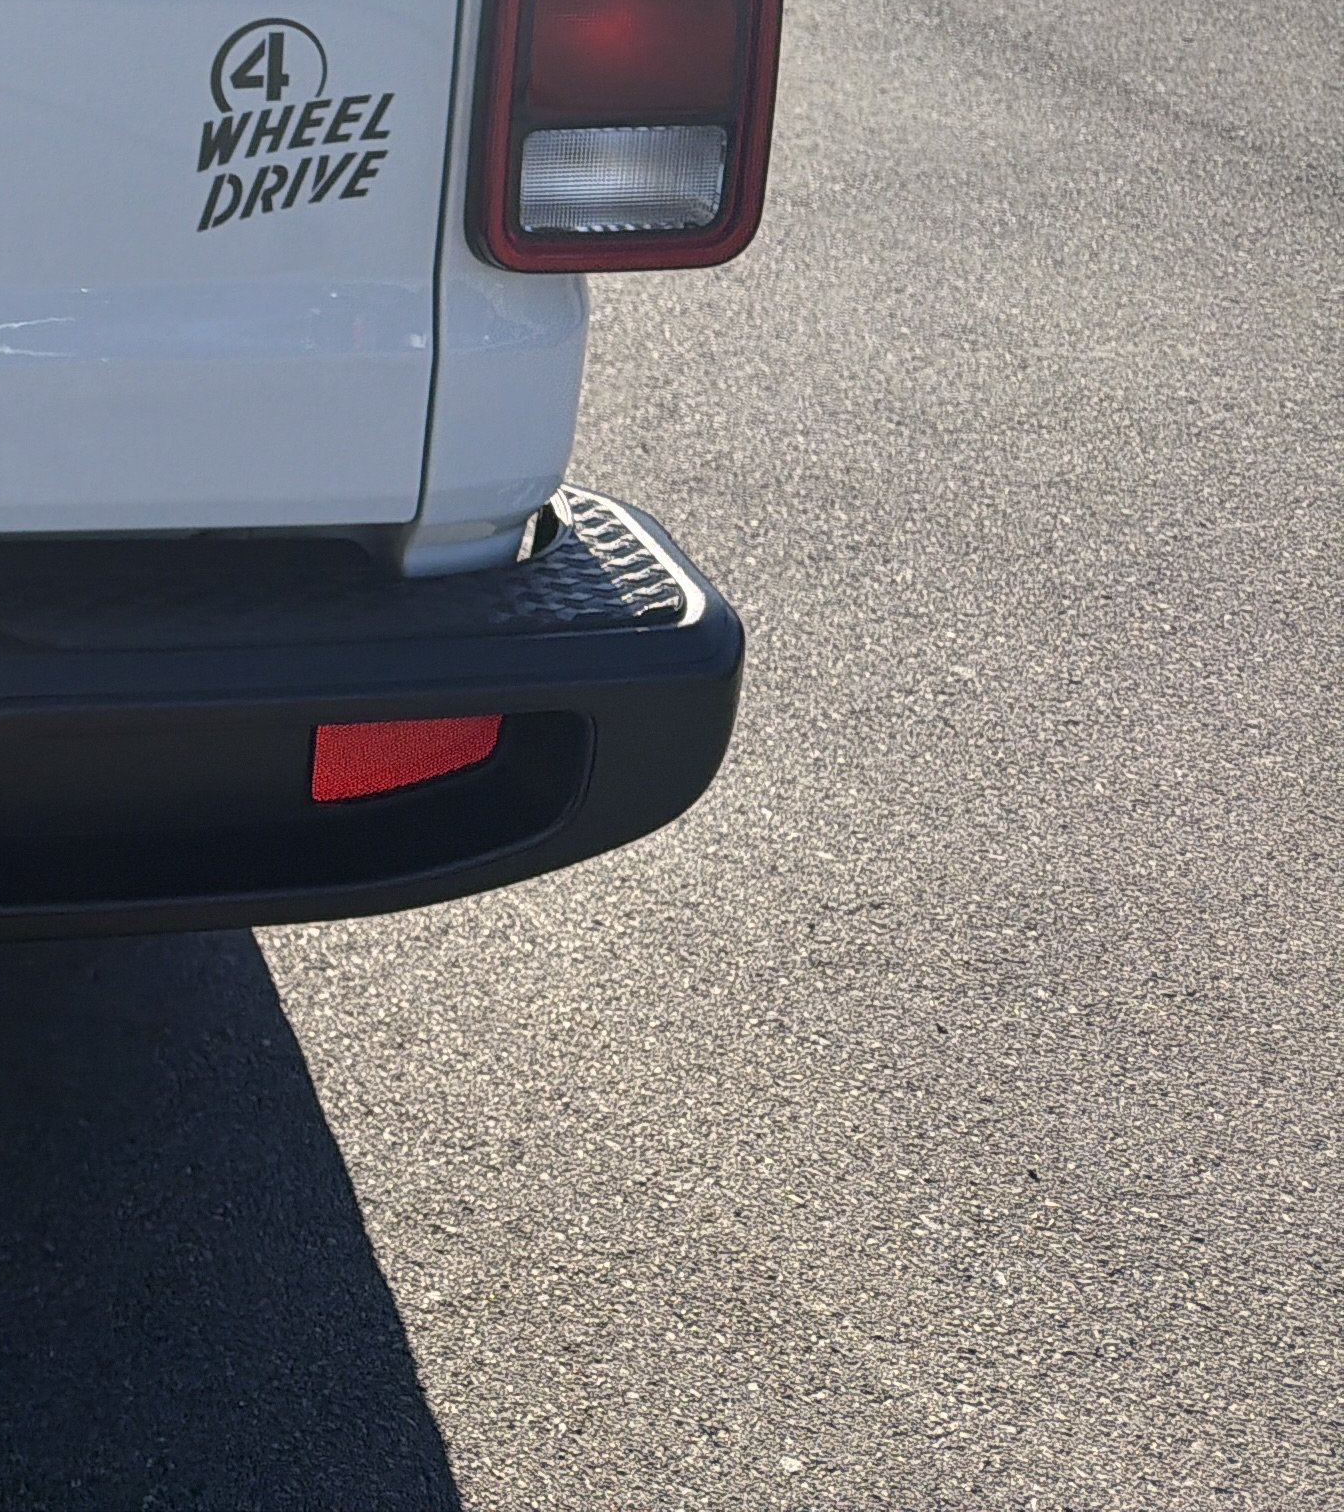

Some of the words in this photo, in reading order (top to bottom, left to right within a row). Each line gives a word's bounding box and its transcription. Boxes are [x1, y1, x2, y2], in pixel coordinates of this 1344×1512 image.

[229, 32, 290, 101] 4
[196, 93, 395, 172] WHEEL
[196, 150, 389, 232] DRIVE
